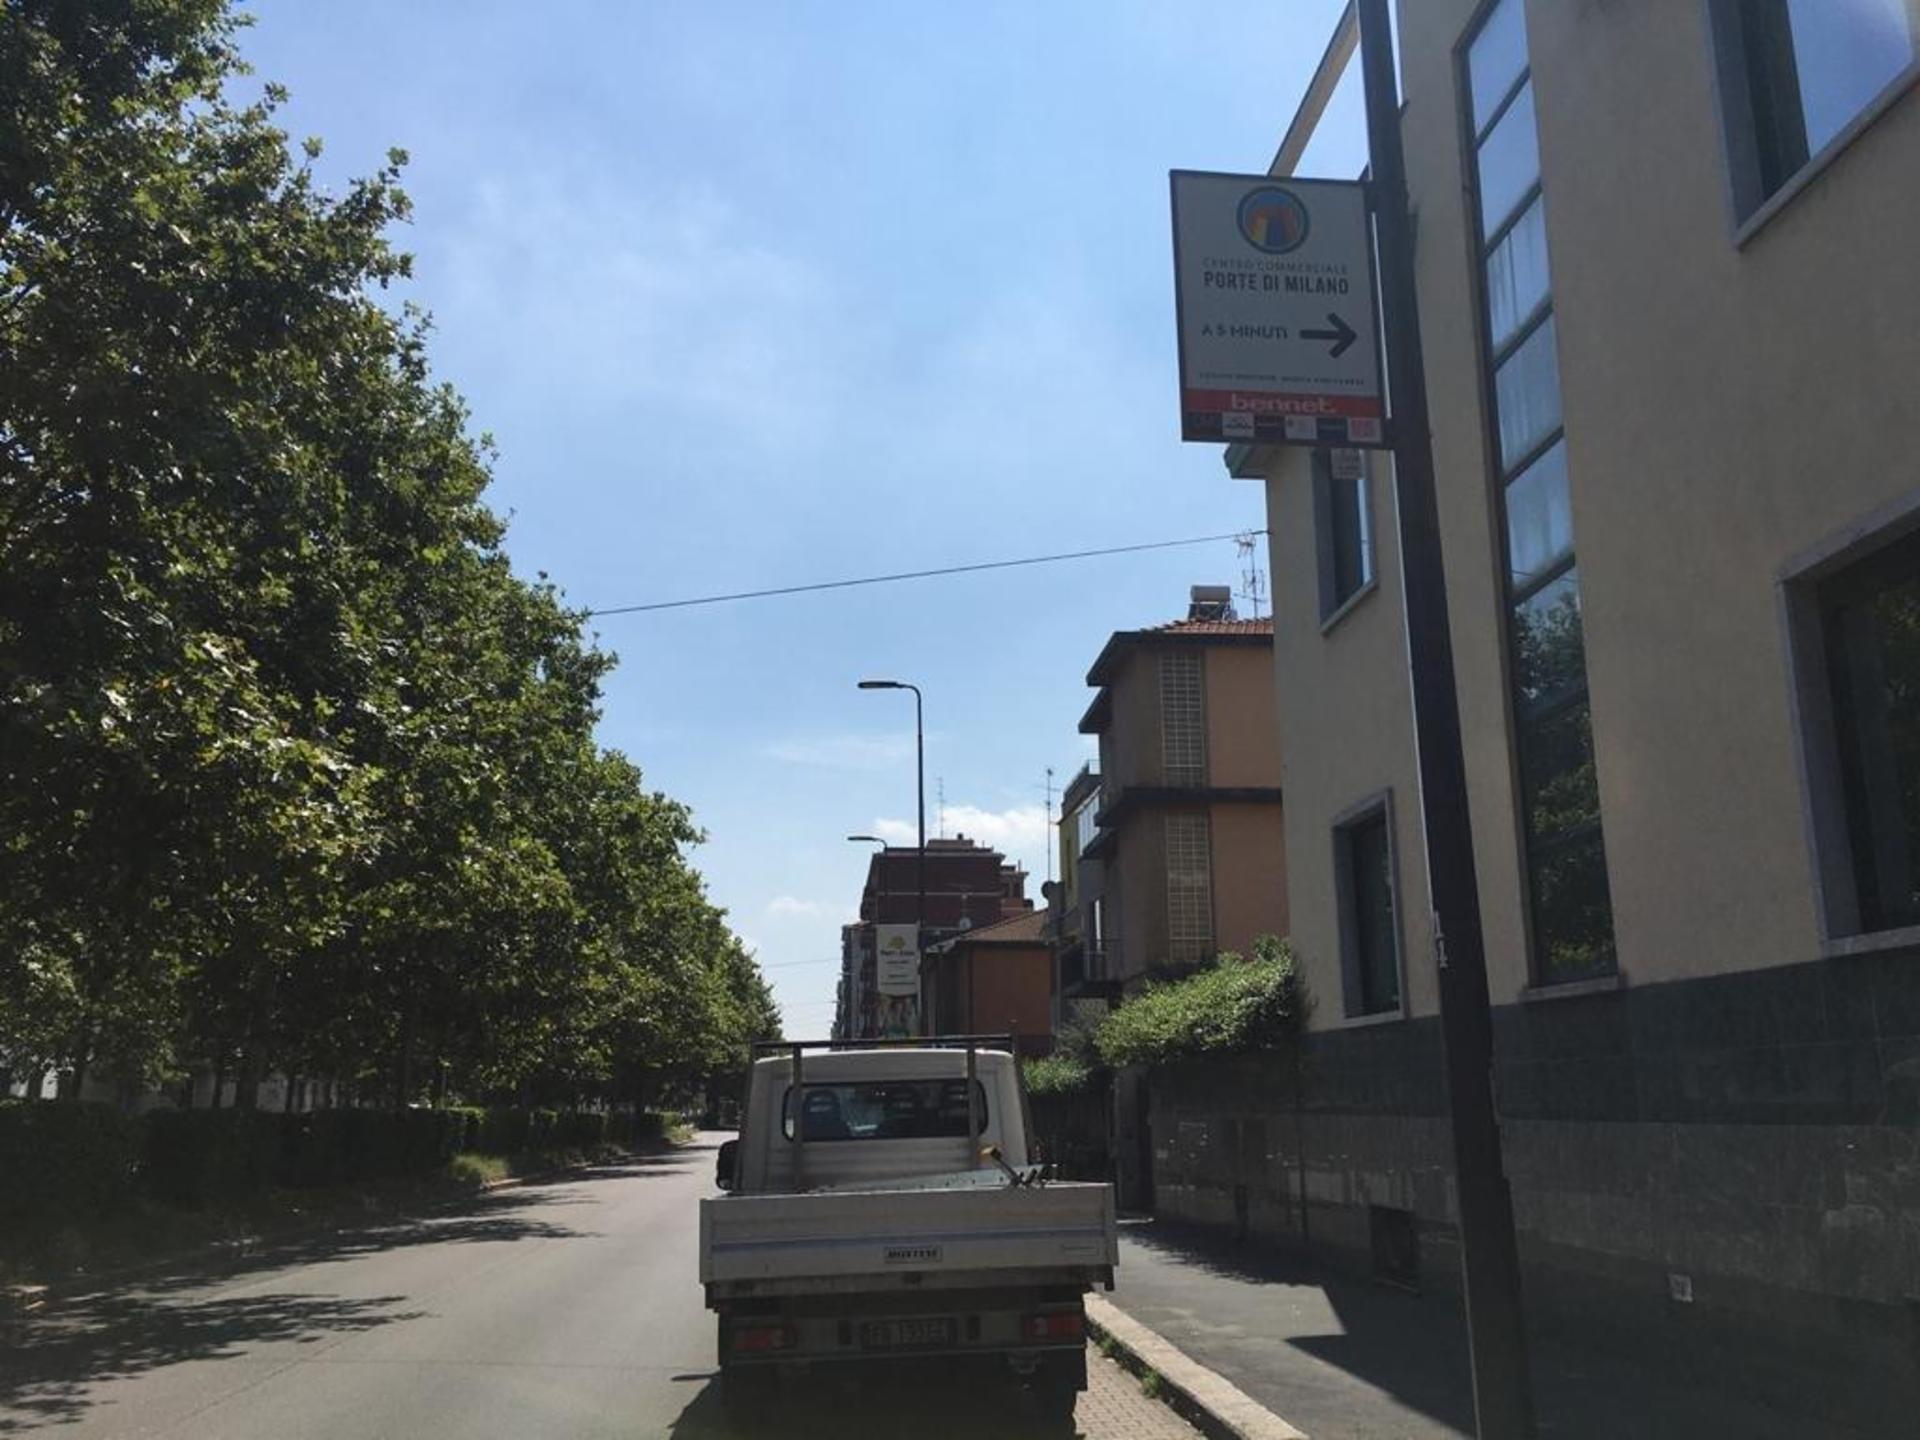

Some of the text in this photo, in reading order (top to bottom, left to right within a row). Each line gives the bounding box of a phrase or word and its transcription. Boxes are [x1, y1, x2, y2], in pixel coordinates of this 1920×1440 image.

[1203, 271, 1350, 296] PORTE DI MILANO
[1201, 323, 1288, 339] A 5 MINUTI
